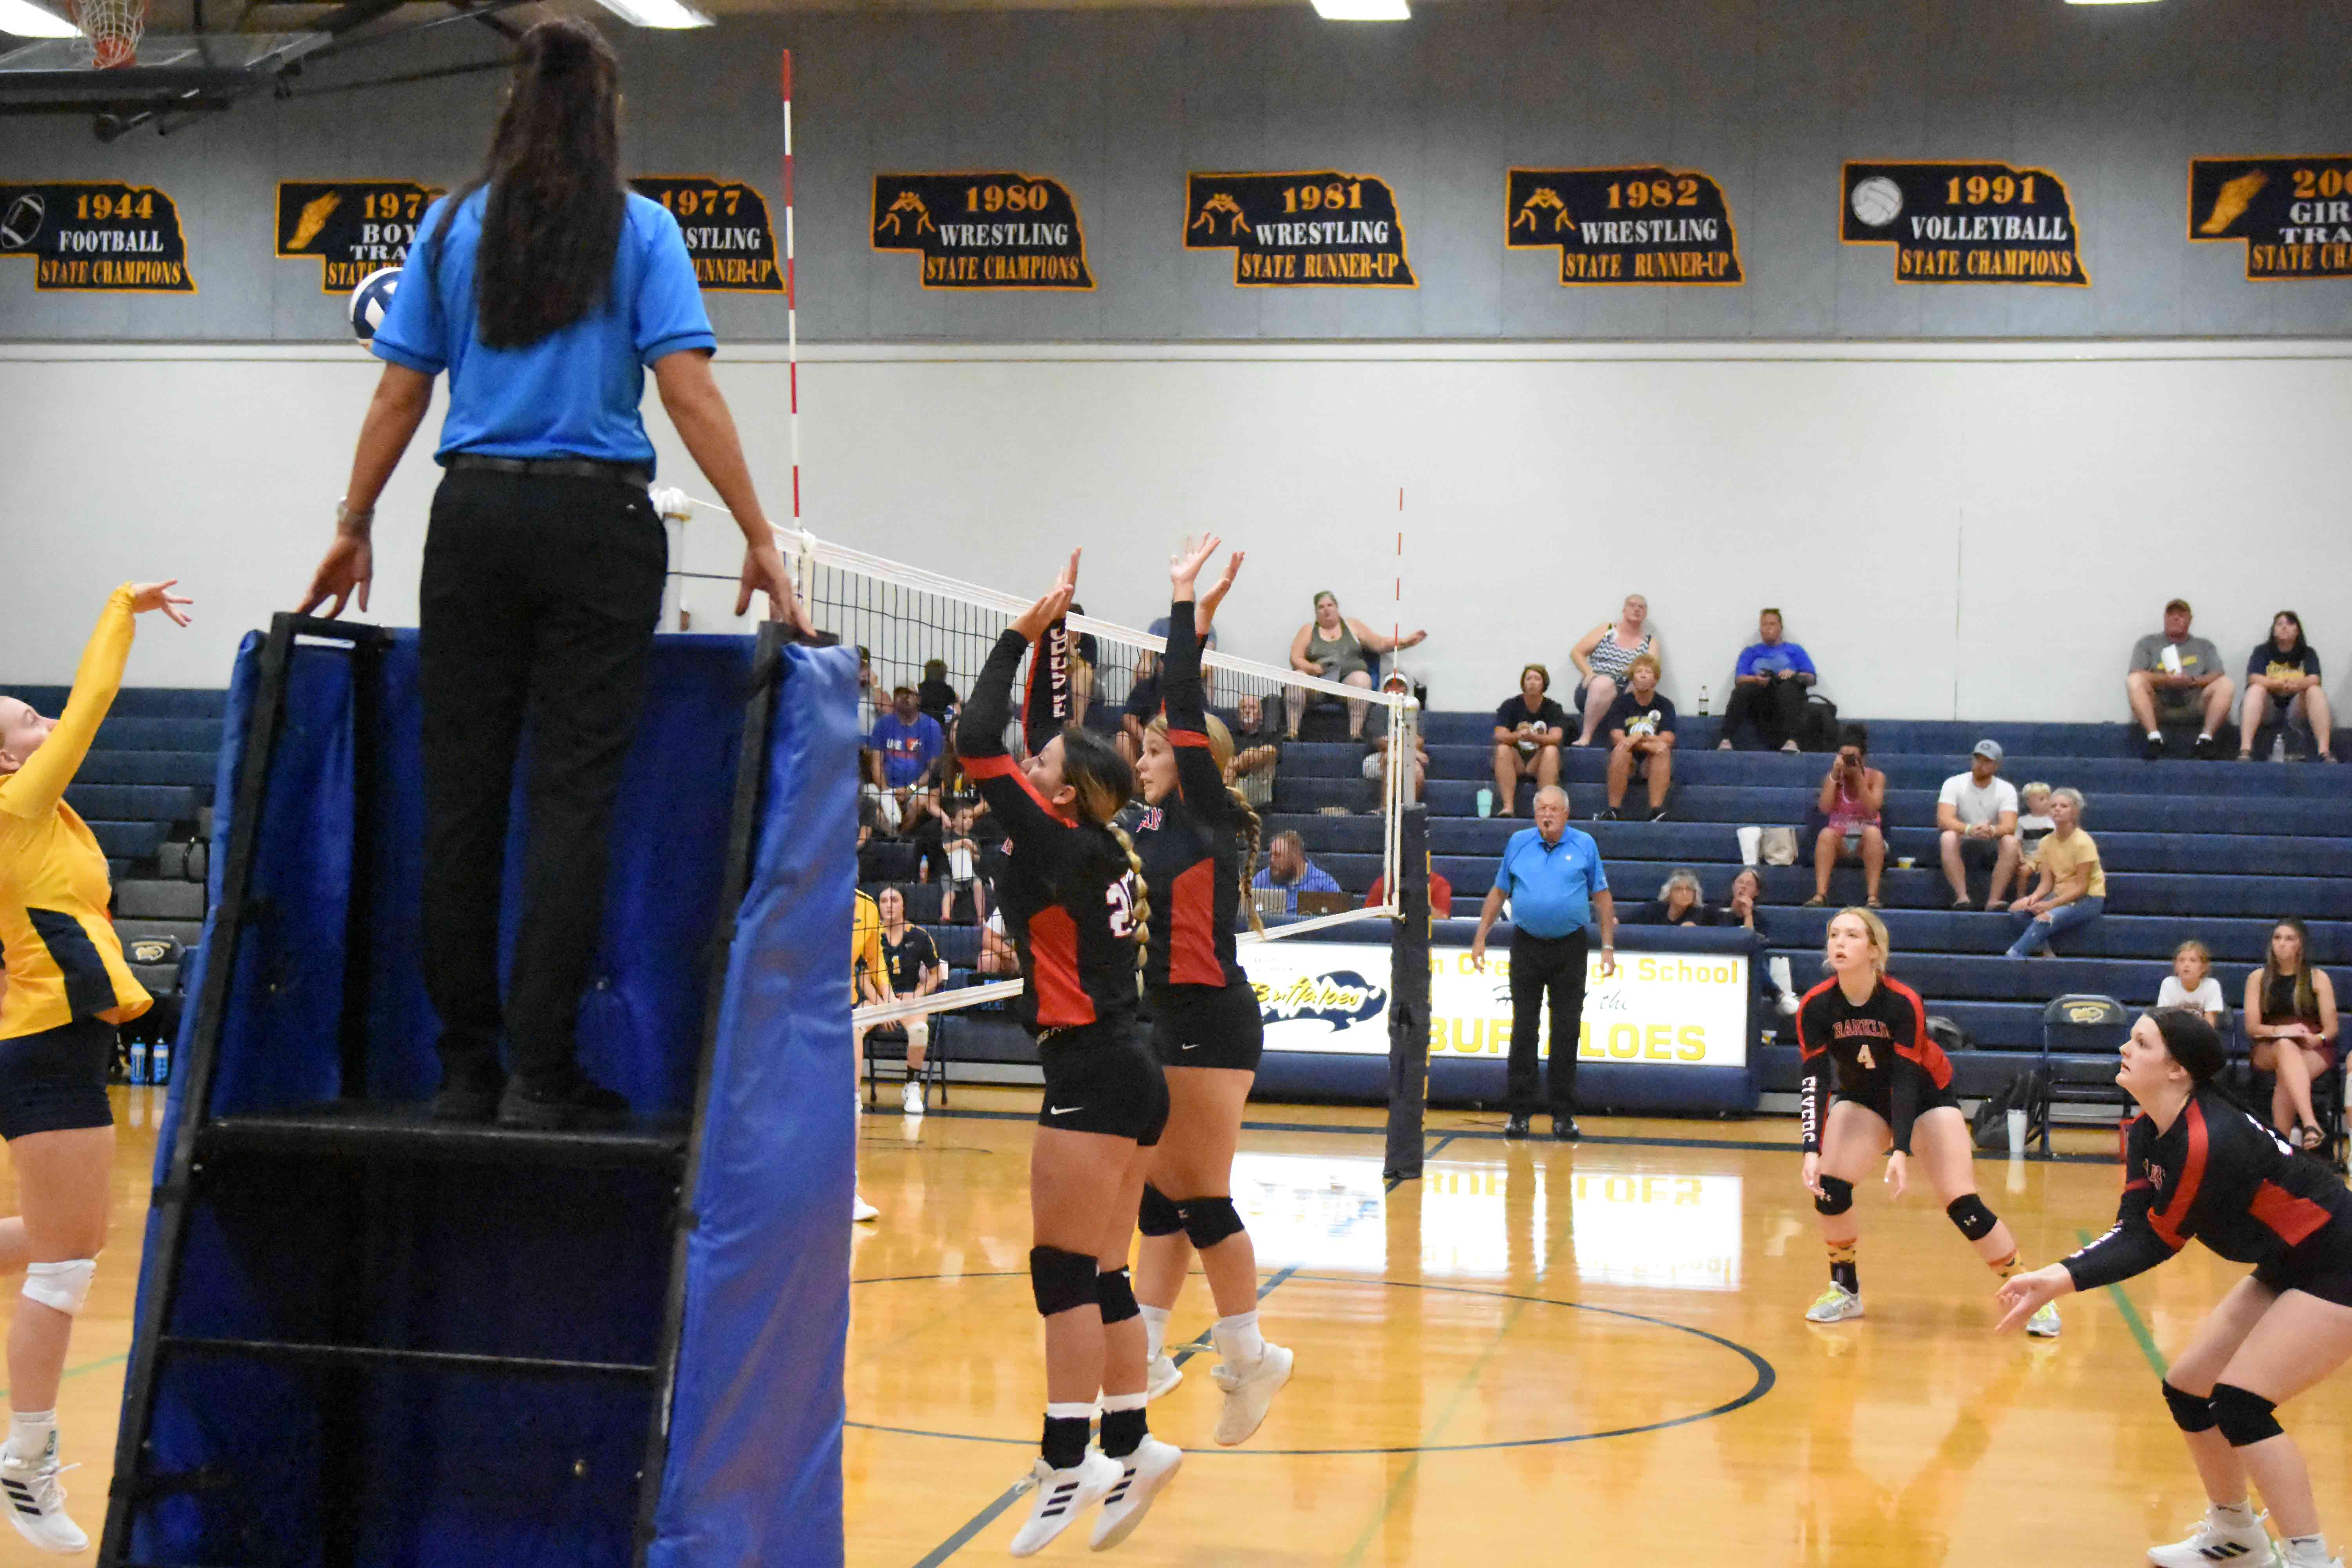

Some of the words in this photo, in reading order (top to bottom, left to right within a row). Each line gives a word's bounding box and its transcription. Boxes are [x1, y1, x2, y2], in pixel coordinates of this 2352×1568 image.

[661, 190, 741, 216] 1977
[966, 185, 1048, 212] 1980
[1283, 182, 1363, 213] 1981
[1607, 179, 1698, 209] 1982
[1945, 175, 2037, 205] 1991
[76, 193, 153, 220] 1944
[364, 192, 442, 219] 197
[59, 229, 164, 252] FOOTBALL
[362, 224, 420, 244] BOY
[680, 227, 761, 250] STLING
[939, 223, 1069, 247] WRESTLING
[1256, 221, 1389, 246] WRESTLING
[1580, 218, 1718, 244] WRESTLING
[1911, 216, 2067, 241] VOLLEYBALL
[350, 245, 408, 260] TRA
[1241, 253, 1296, 278] STATE
[1304, 253, 1399, 278] RUNNER-UP
[1566, 253, 1622, 278] STATE
[1634, 252, 1729, 278] RUNNER-UP
[1901, 249, 1960, 276] STATE
[1967, 249, 2073, 276] CHAMPIONS
[2252, 244, 2314, 270] STATE
[40, 259, 89, 283] STATE
[93, 260, 181, 285] CHAMPIONS
[691, 258, 772, 283] UNNER-UP
[926, 256, 979, 280] STATE
[984, 255, 1079, 280] CHAMPIONS
[1637, 958, 1737, 984] School
[1429, 1017, 1706, 1060] BUFLOES
[1857, 1044, 1876, 1069] 4
